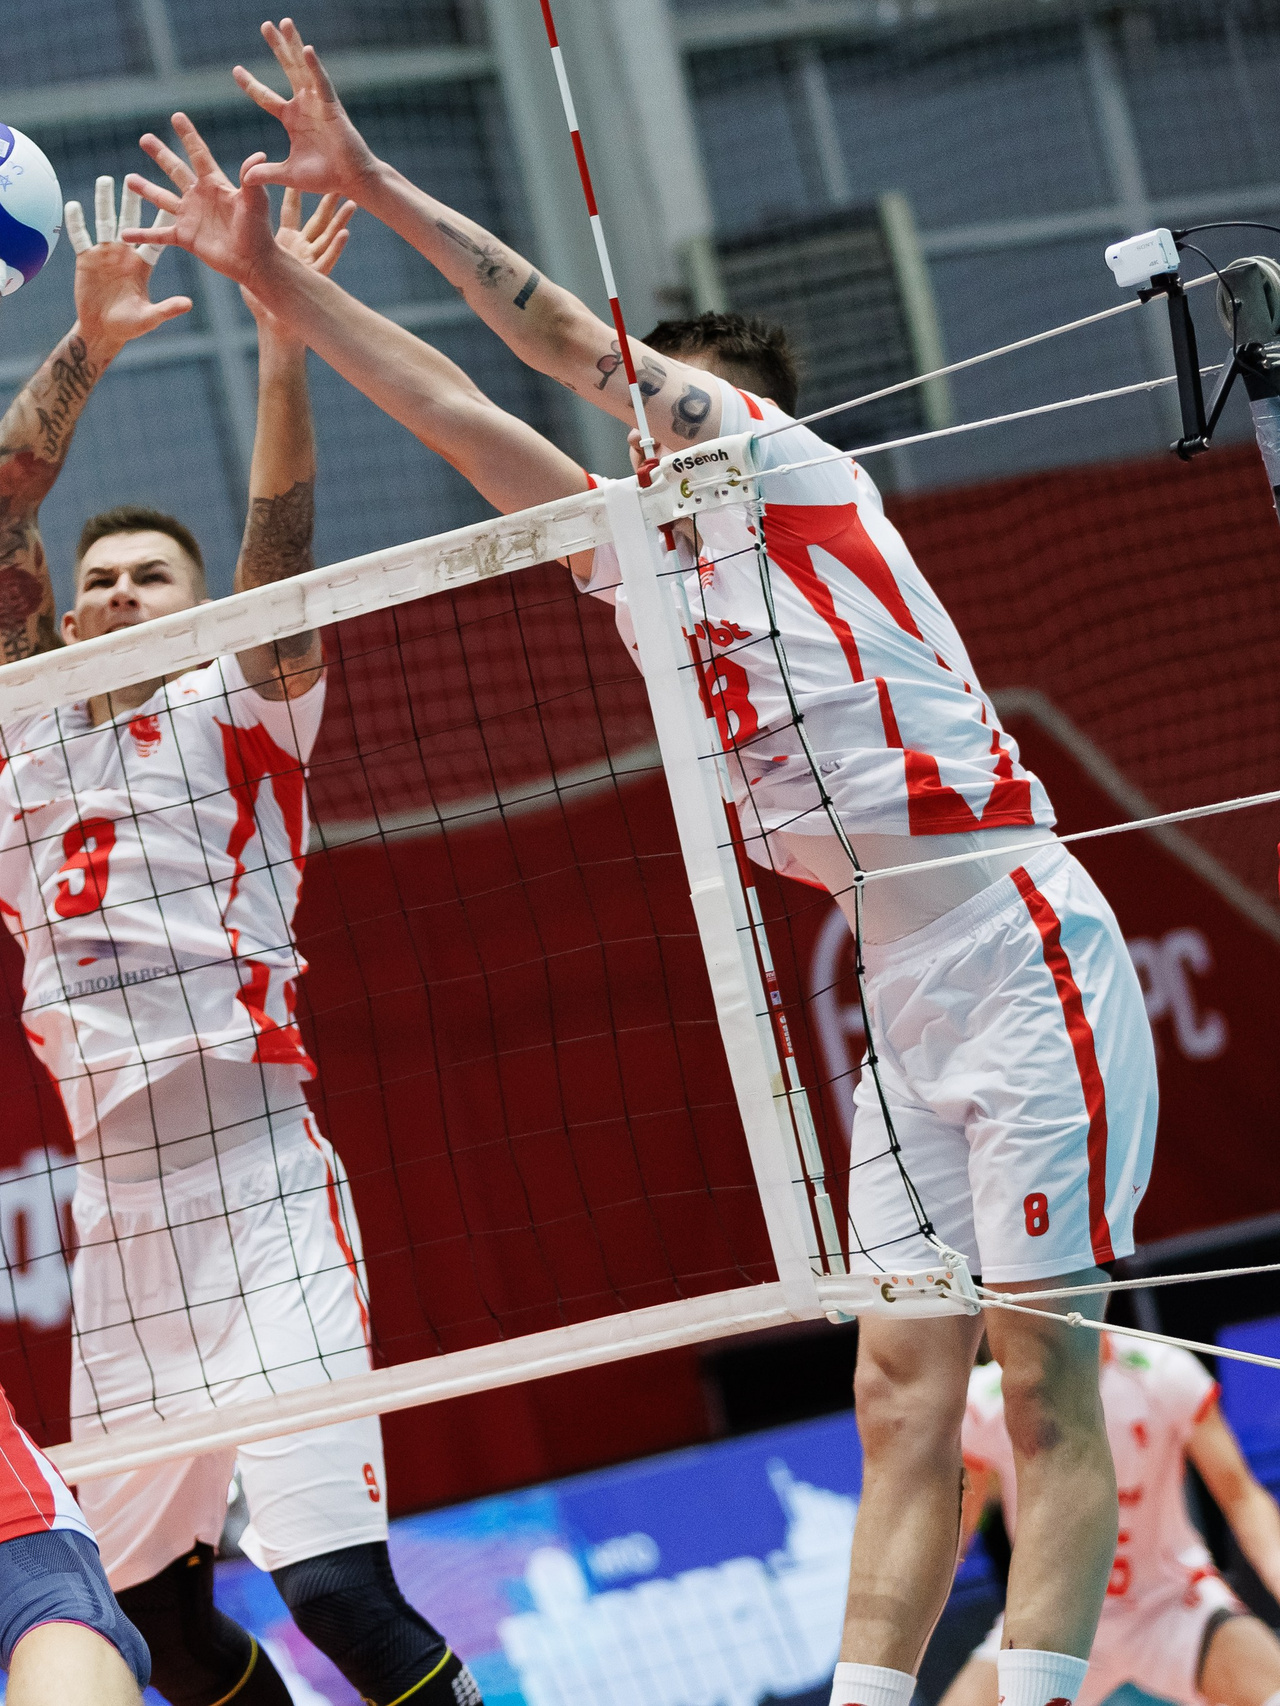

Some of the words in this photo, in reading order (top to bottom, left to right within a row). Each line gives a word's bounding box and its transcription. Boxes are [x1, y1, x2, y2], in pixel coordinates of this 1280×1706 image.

[684, 448, 729, 470] Senoh
[697, 654, 759, 752] 8
[1023, 1192, 1050, 1237] 8
[362, 1462, 381, 1502] 9
